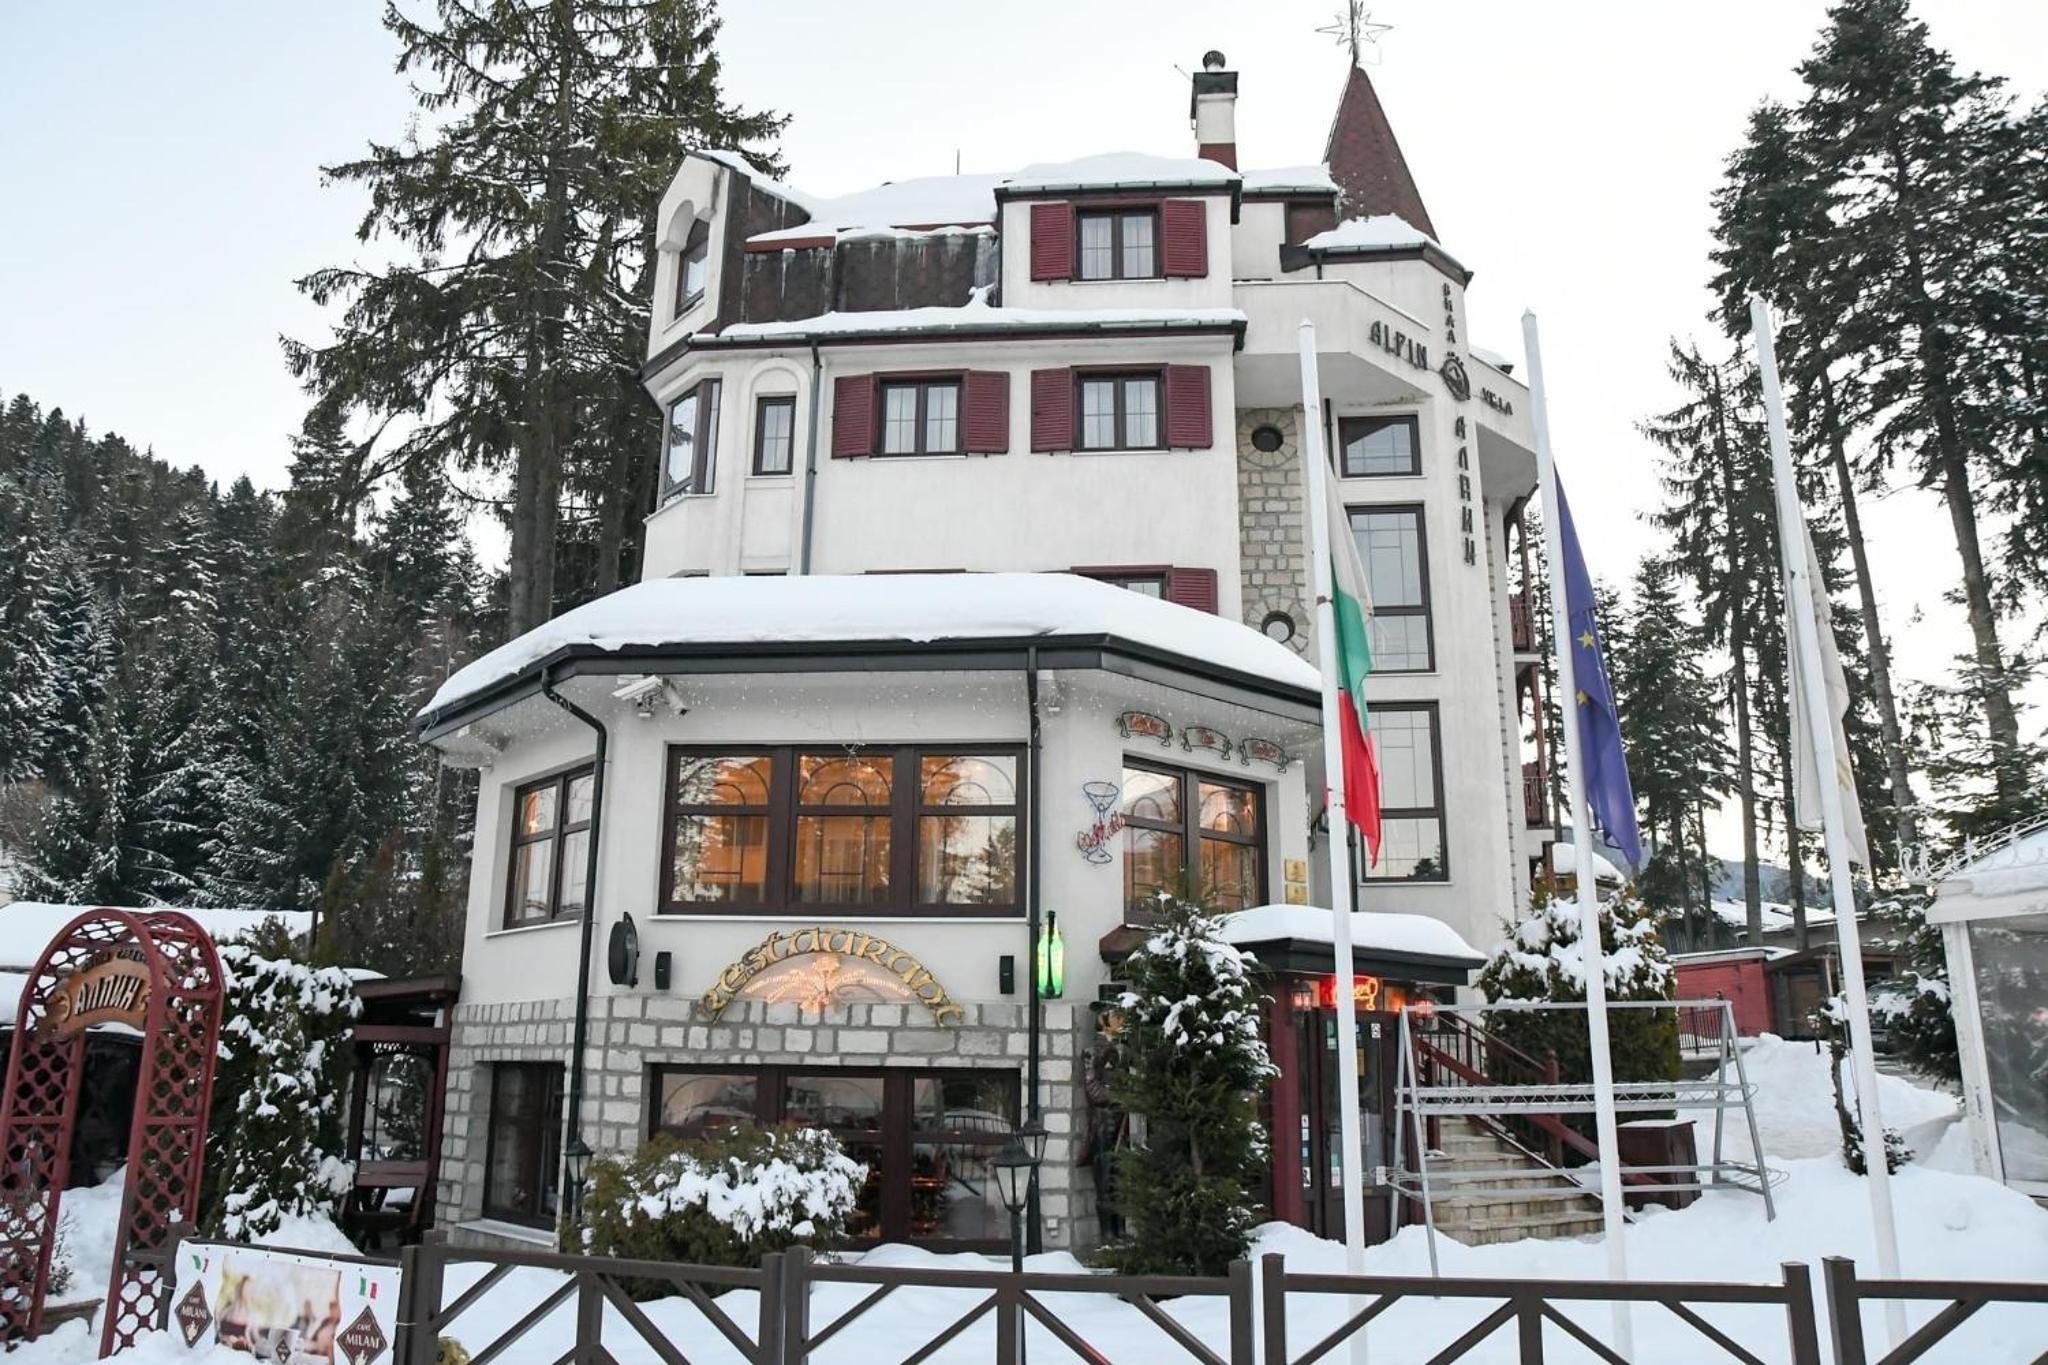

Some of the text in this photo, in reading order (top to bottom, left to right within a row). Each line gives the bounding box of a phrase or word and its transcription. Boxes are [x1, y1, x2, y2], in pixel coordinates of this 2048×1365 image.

[1369, 320, 1429, 371] ALPIN
[74, 974, 141, 1016] АЛПИН
[345, 1333, 381, 1349] MILANI
